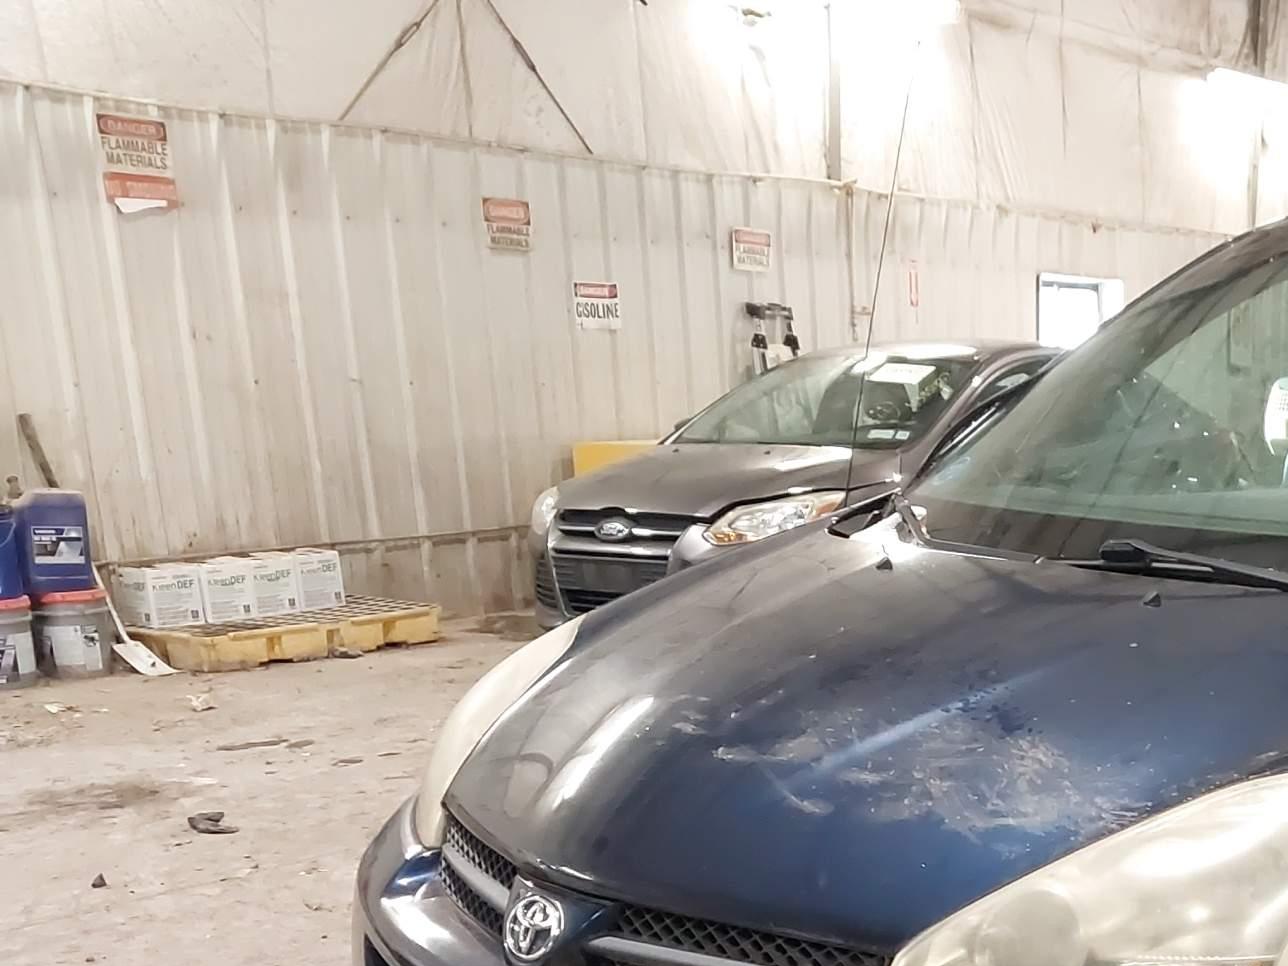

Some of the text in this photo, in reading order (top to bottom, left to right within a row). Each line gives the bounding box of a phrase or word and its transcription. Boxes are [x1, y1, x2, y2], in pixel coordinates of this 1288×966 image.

[101, 136, 168, 156] FLAMMABLE
[105, 151, 168, 170] MATERIALS
[576, 302, 620, 319] GSOLINE
